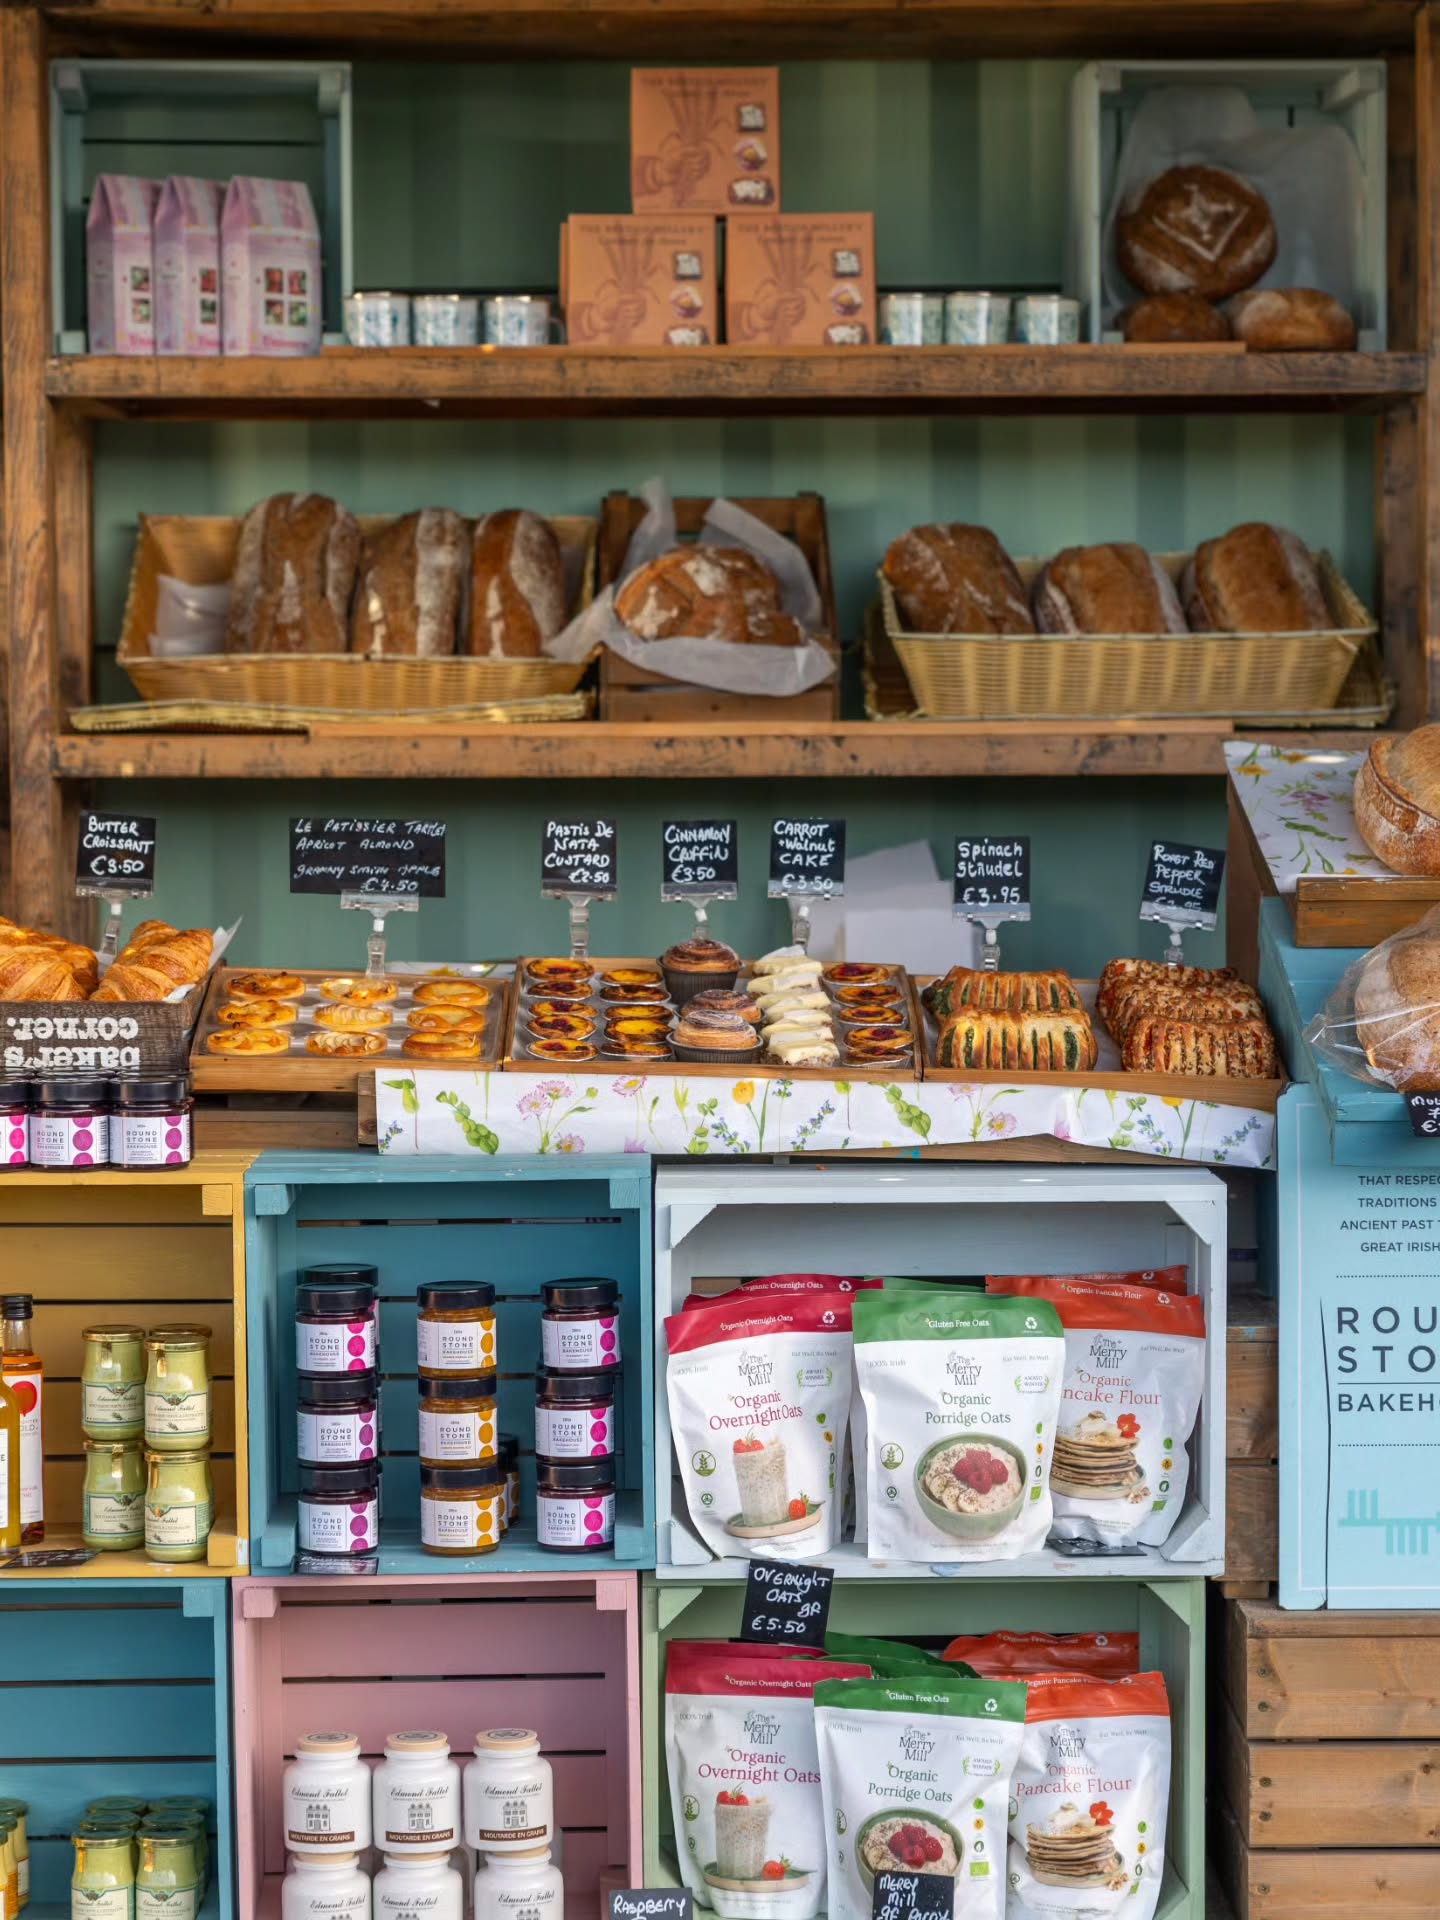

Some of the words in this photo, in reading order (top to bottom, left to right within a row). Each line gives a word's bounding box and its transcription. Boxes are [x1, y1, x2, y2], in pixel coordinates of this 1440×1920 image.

[88, 815, 139, 836] BUTTER
[295, 819, 312, 833] LE
[773, 820, 829, 841] CARROT
[82, 834, 155, 854] CROISSANT
[295, 837, 346, 850] APRICOT
[360, 839, 415, 850] ALMOND
[554, 838, 599, 851] NATA
[958, 838, 1022, 861] Spinach
[544, 854, 610, 868] CUSTARD
[779, 853, 833, 867] CAKE
[569, 868, 610, 883] €2.50
[671, 864, 716, 883] €3.50
[1154, 863, 1206, 886] PEPPER
[782, 873, 834, 890] €3.50
[963, 886, 1020, 906] €3.95
[7, 1017, 139, 1040] corner.
[1358, 1176, 1391, 1185] THAT
[1358, 1197, 1437, 1208] TRADITIONS
[1340, 1220, 1398, 1230] ANCIENT
[1402, 1219, 1434, 1230] PAST
[1360, 1242, 1403, 1252] GREAT
[770, 1281, 806, 1290] Overnight
[807, 1281, 824, 1289] Oats
[1067, 1287, 1094, 1295] Organic
[1124, 1291, 1142, 1299] Flour
[928, 1319, 954, 1329] Gluten
[955, 1319, 971, 1328] Free
[972, 1319, 990, 1328] Oats
[1089, 1345, 1127, 1360] Merry
[738, 1362, 773, 1377] Merry
[946, 1363, 982, 1376] Merry
[1096, 1358, 1119, 1368] Mill
[748, 1374, 771, 1387] Mill
[954, 1375, 977, 1386] Mill
[1079, 1372, 1131, 1387] Organic
[734, 1390, 782, 1409] Organic
[942, 1393, 991, 1408] Organic
[1063, 1388, 1113, 1403] ncake
[1119, 1389, 1162, 1405] Flour
[1338, 1393, 1440, 1412] BAKEH
[709, 1408, 782, 1431] Overnight
[782, 1405, 803, 1420] Oats
[925, 1411, 977, 1427] Porridge
[981, 1412, 1011, 1423] Oats
[766, 1589, 802, 1603] OATS
[752, 1615, 806, 1633] €5.50
[729, 1678, 757, 1687] Organic
[759, 1680, 794, 1688] Overnight
[888, 1692, 914, 1702] Gluten
[915, 1694, 932, 1703] Free
[933, 1694, 950, 1703] Oats
[743, 1721, 781, 1736] Merry
[750, 1733, 773, 1744] Mill
[899, 1737, 936, 1753] Merry
[1050, 1735, 1087, 1748] Merry
[730, 1749, 786, 1765] Organic
[904, 1750, 928, 1762] Mill
[1058, 1746, 1081, 1758] Mill
[698, 1763, 778, 1784] Overnight
[784, 1767, 821, 1783] Oats
[888, 1766, 938, 1783] Organic
[1048, 1764, 1096, 1777] Organic
[868, 1782, 920, 1801] Porridge
[924, 1788, 953, 1802] Oats
[1016, 1778, 1081, 1797] Pancake
[1087, 1779, 1132, 1793] Flour
[319, 1834, 329, 1842] EN
[310, 1899, 341, 1910] Edmond
[498, 1893, 532, 1904] Edmond
